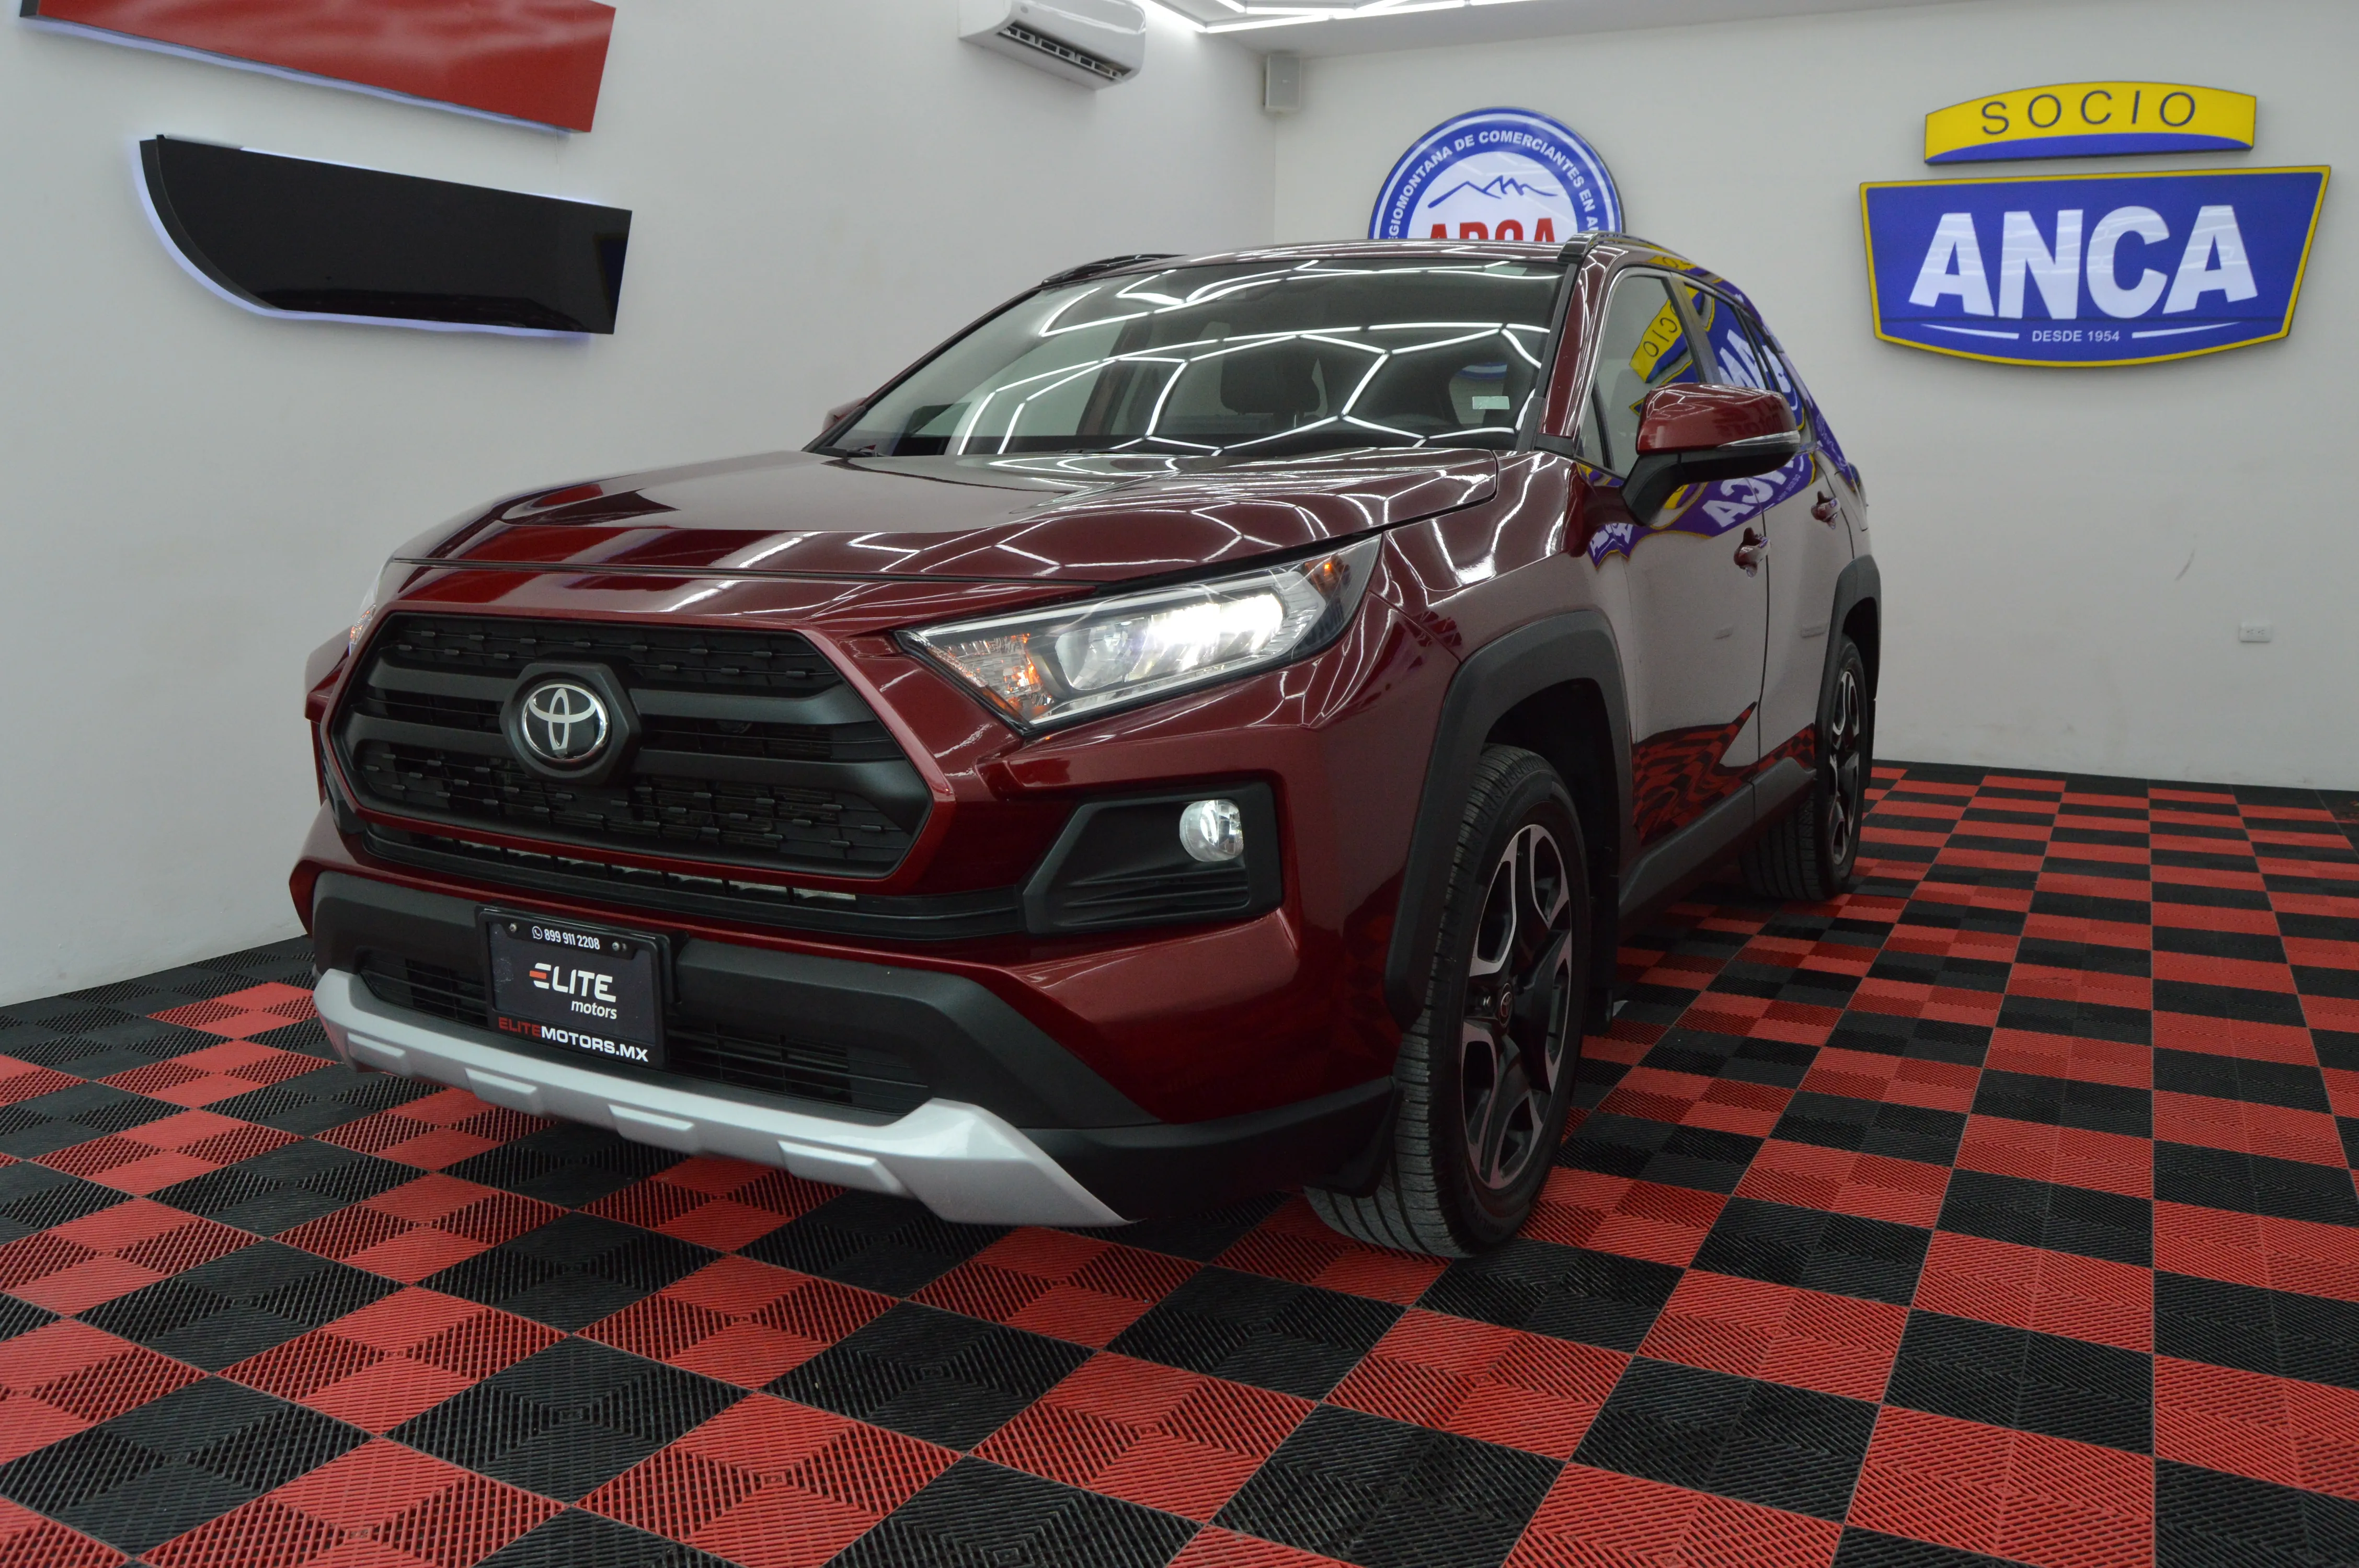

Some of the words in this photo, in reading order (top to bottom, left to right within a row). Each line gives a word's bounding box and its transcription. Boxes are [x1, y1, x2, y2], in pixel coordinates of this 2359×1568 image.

[1981, 90, 2196, 135] SOCIO
[1388, 146, 1453, 239] GIOMONTANA
[1454, 134, 1475, 151] DE
[1479, 130, 1584, 188] COMERCIANTES
[1579, 189, 1596, 212] EN
[1908, 205, 2258, 320] ANCA
[2032, 330, 2082, 342] DESDE
[2087, 329, 2120, 342] 1954
[544, 929, 560, 942] 899
[563, 932, 575, 946] 911
[577, 935, 600, 950] 2208
[529, 963, 616, 1002] ELITE
[571, 1001, 617, 1019] motors
[498, 1017, 649, 1062] ELITEMOTORS.MX
